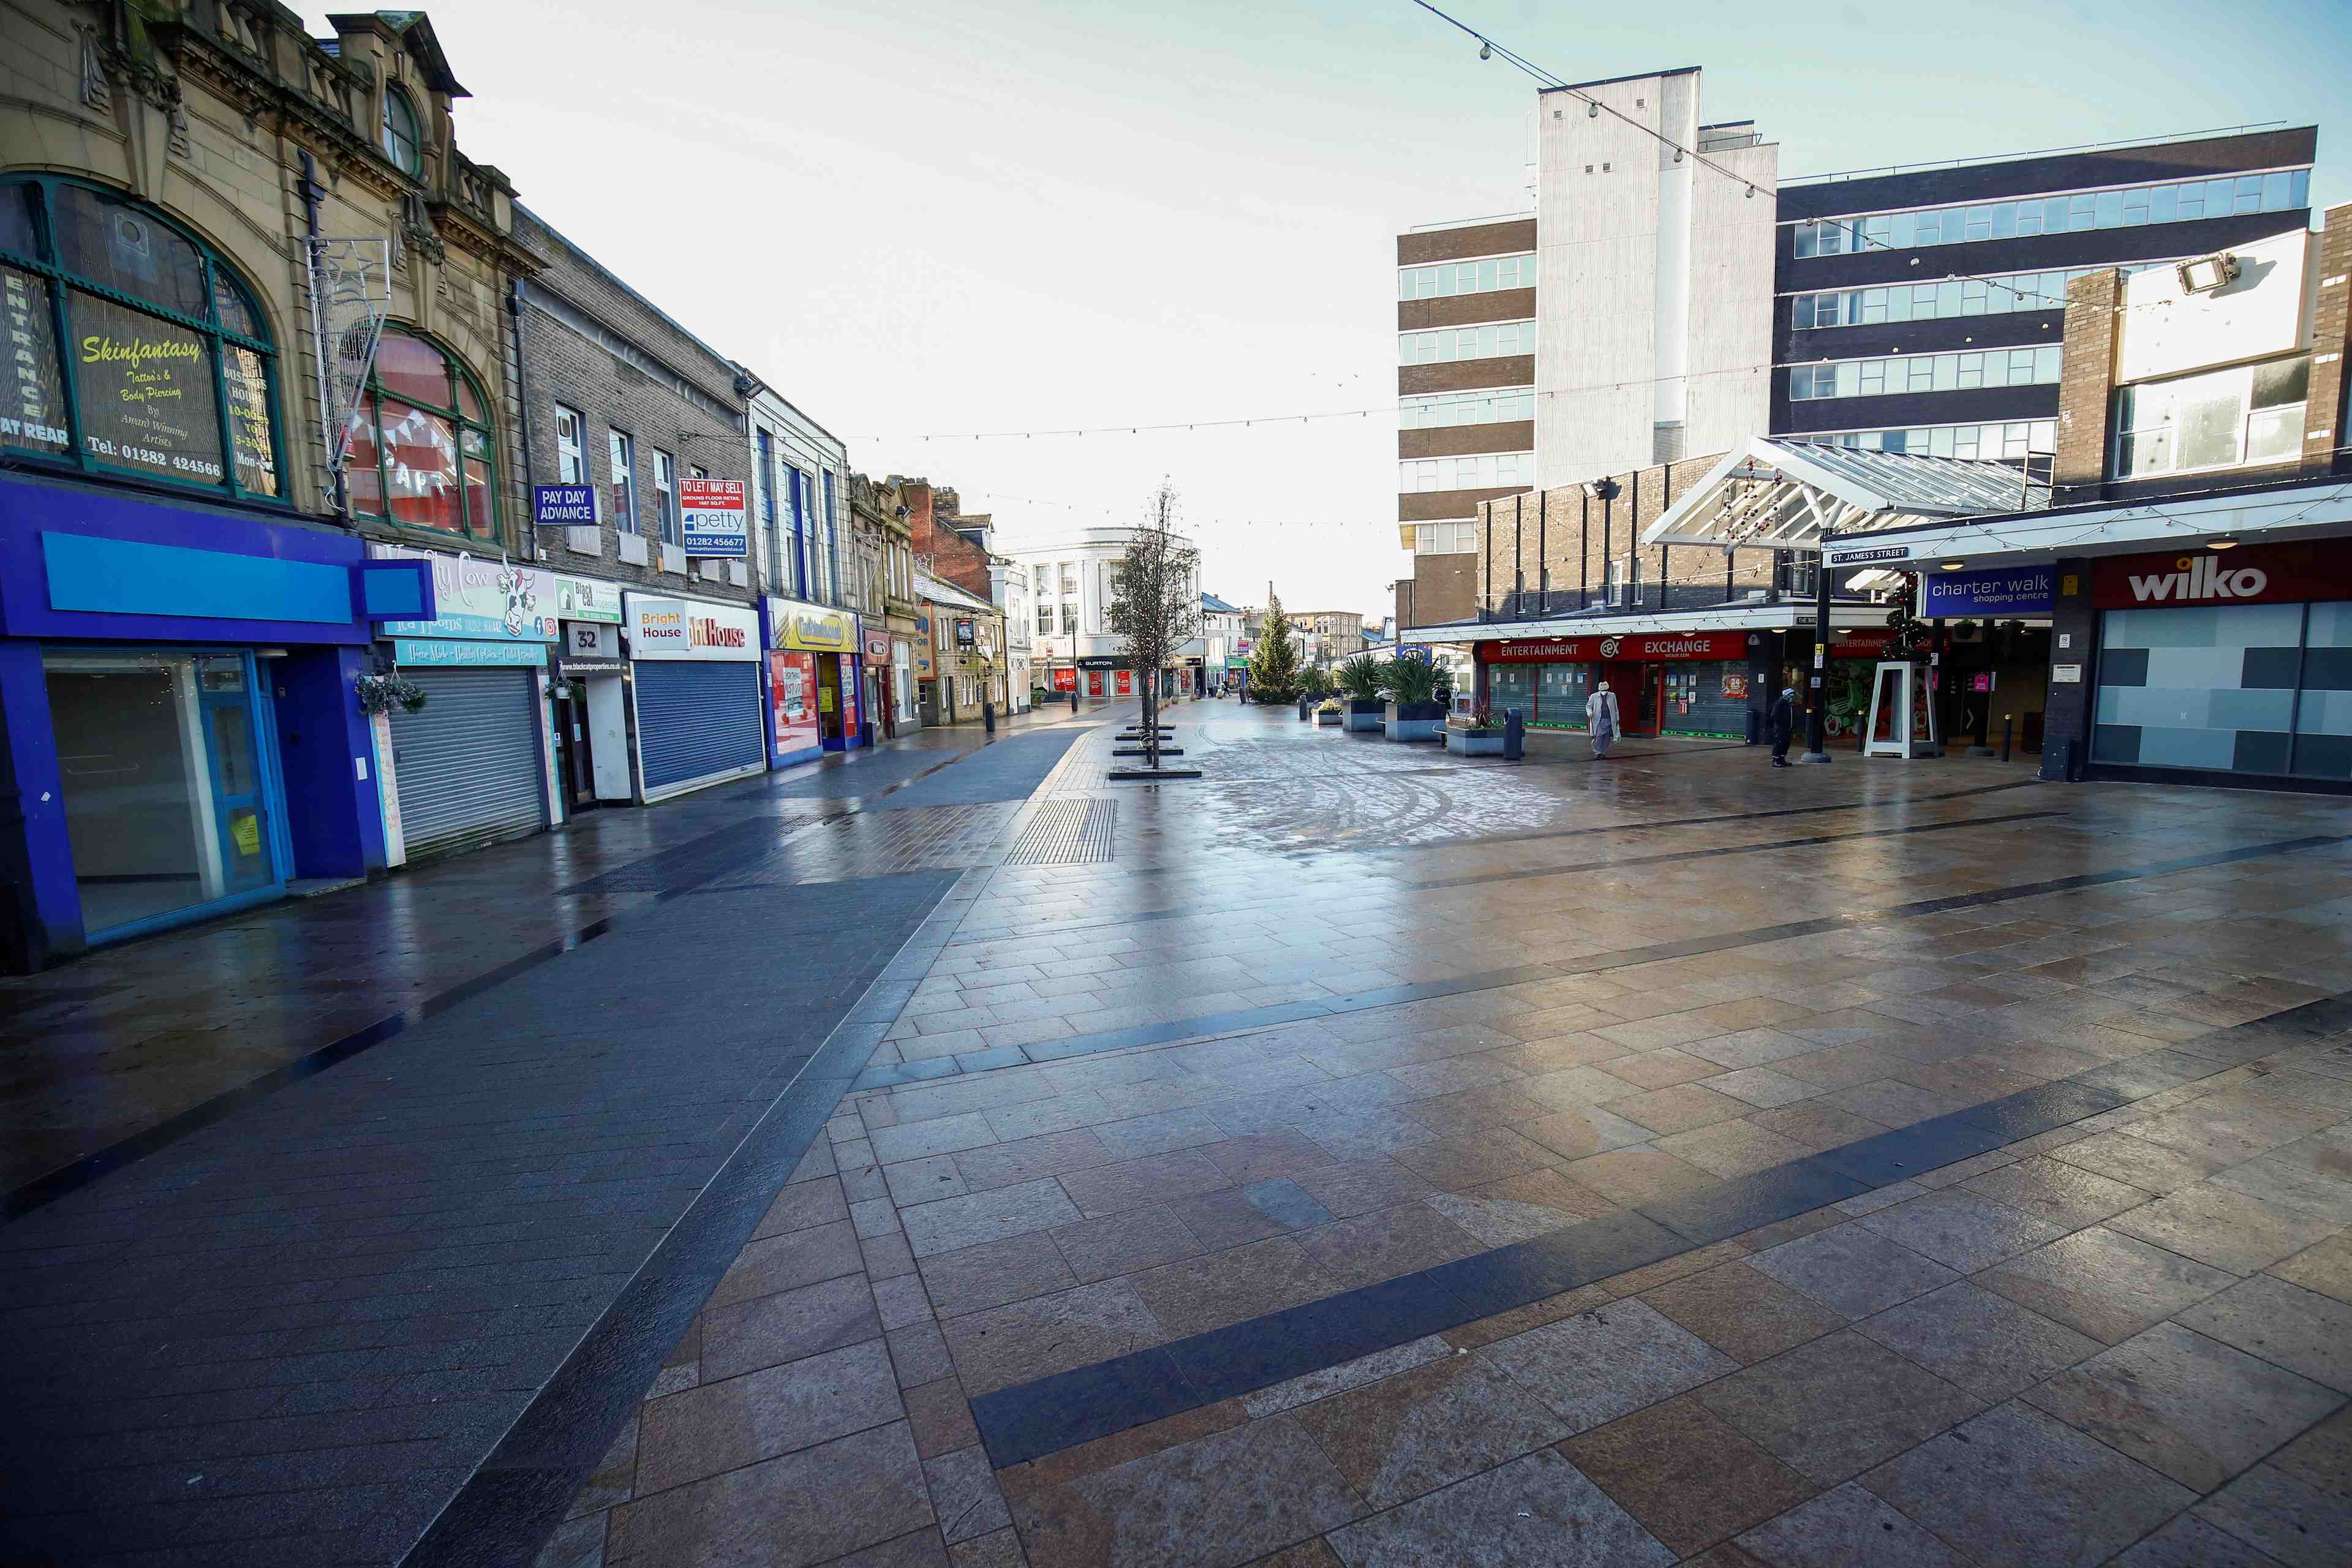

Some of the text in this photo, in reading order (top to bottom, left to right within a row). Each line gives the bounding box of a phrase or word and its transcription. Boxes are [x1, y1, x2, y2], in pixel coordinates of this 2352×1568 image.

[5, 276, 42, 418] ENTRANCE
[83, 336, 201, 368] Skinfantasy
[127, 369, 171, 383] Tattoo's &
[120, 386, 181, 402] Body Piercing
[232, 386, 262, 402] HOU
[146, 405, 159, 418] By
[0, 417, 69, 445] AT REAR
[121, 415, 188, 440] Award Winning
[143, 434, 172, 447] Artists
[88, 436, 221, 477] Tel: 01282 424566
[682, 481, 692, 492] TO
[693, 481, 706, 492] LET
[710, 482, 724, 493] MAY
[725, 483, 742, 494] SELL
[542, 491, 586, 504] PAY DAY
[540, 507, 591, 519] ADVANCE
[696, 511, 744, 532] petty
[1845, 551, 1874, 561] JAMES'S
[1877, 548, 1905, 558] STREET
[459, 551, 490, 609] Cow
[1932, 575, 2049, 597] charter walk
[2128, 556, 2267, 601] wilko
[575, 582, 592, 595] Black
[1973, 594, 2013, 603] shopping
[642, 613, 681, 625] Bright
[578, 630, 596, 648] 32
[643, 627, 681, 638] House
[1501, 644, 1579, 657] ENTERTAINMENT
[1645, 640, 1711, 653] EXCHANGE
[1836, 639, 1887, 647] ENTERTAINMEN
